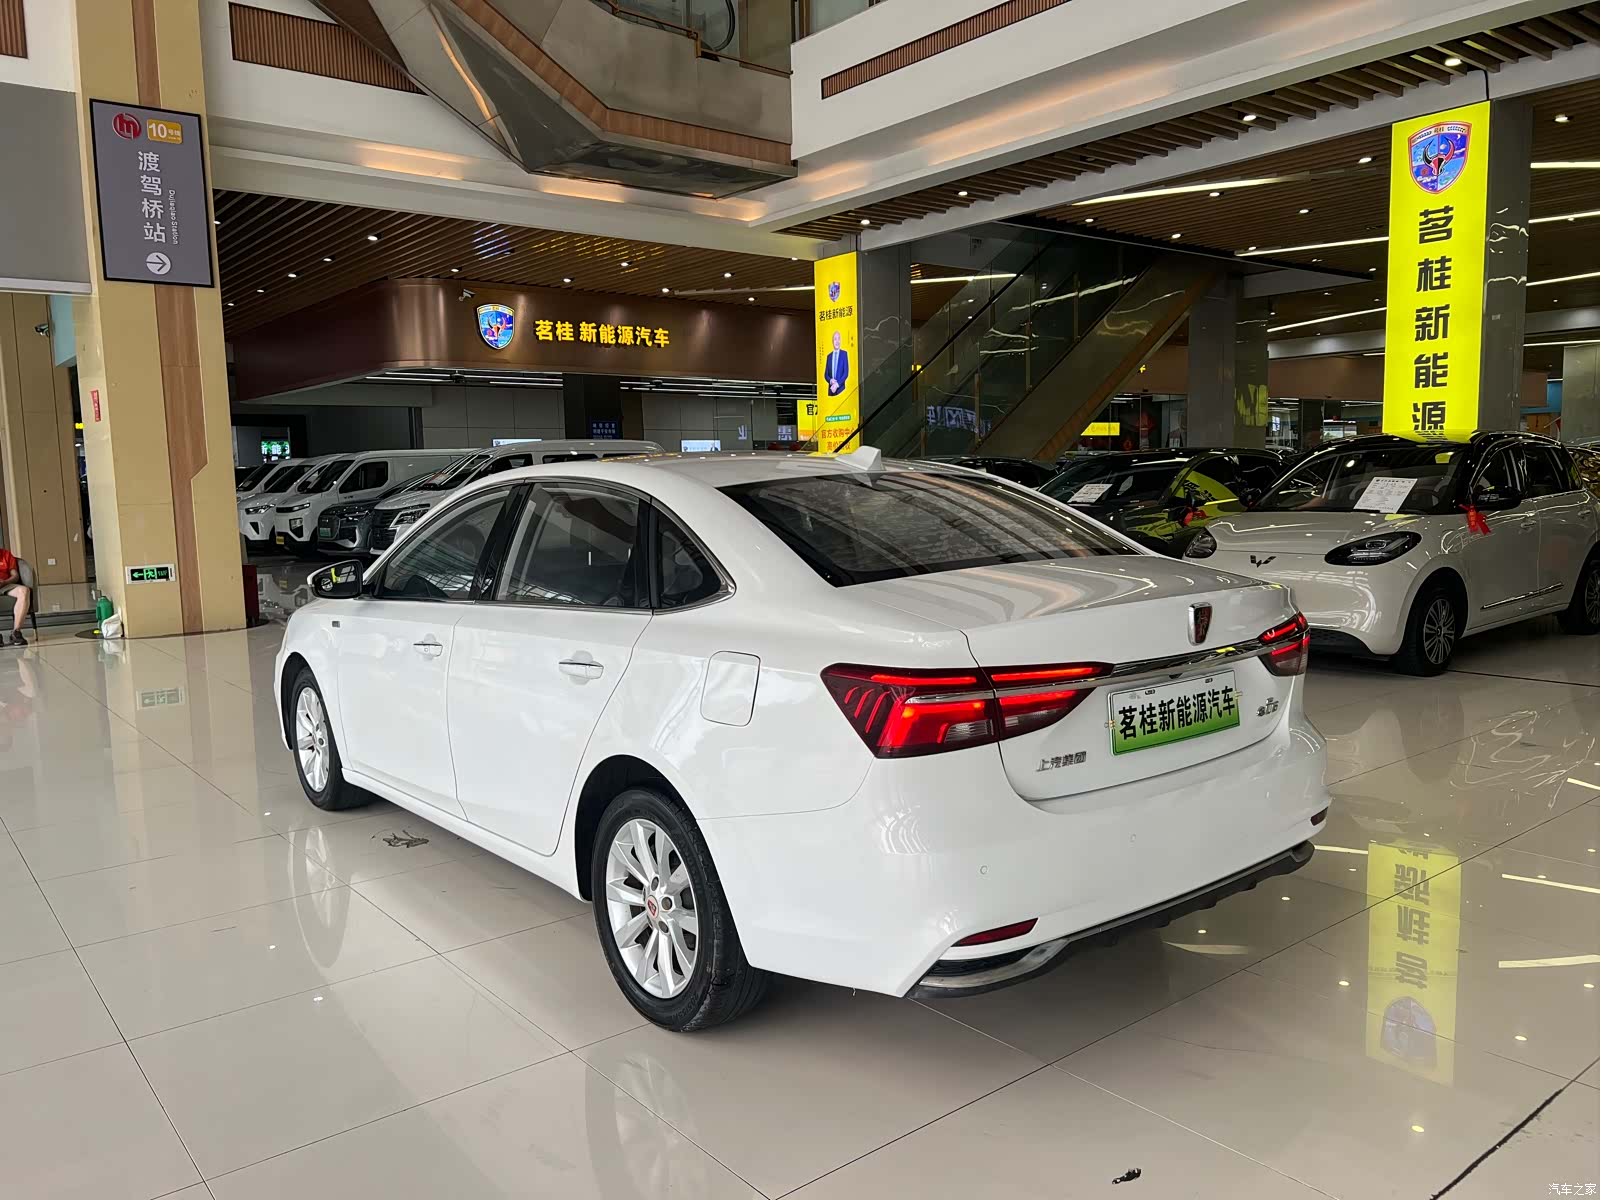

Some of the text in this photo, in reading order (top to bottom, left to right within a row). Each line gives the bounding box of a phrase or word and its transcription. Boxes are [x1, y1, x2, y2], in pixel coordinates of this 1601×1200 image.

[137, 151, 167, 243] 渡驾桥站
[171, 221, 179, 245] Station
[819, 305, 853, 321] 茗桂新能源
[1411, 205, 1454, 431] 茗桂新能源
[535, 320, 670, 347] 茗桂 新能源汽车
[1118, 686, 1236, 740] 茗桂新能源汽车
[1036, 751, 1087, 772] 上汽集团
